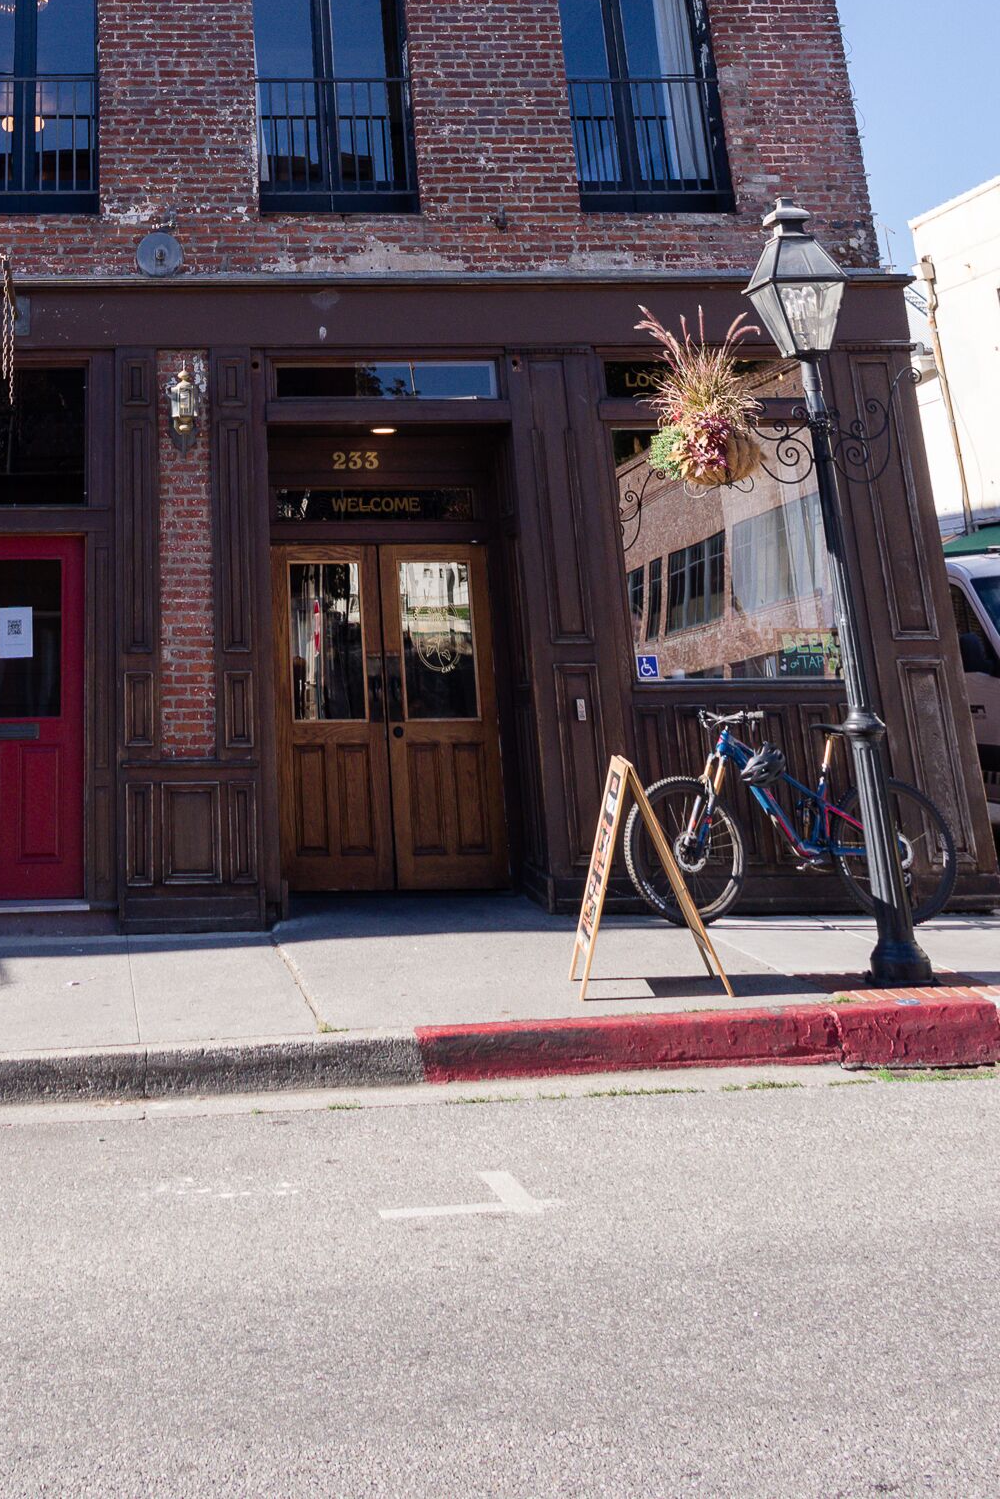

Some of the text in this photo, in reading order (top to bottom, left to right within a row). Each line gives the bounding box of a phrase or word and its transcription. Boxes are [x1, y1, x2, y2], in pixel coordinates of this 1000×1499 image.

[332, 451, 379, 469] 233
[332, 497, 421, 512] WELCOME
[797, 655, 825, 669] TAP
